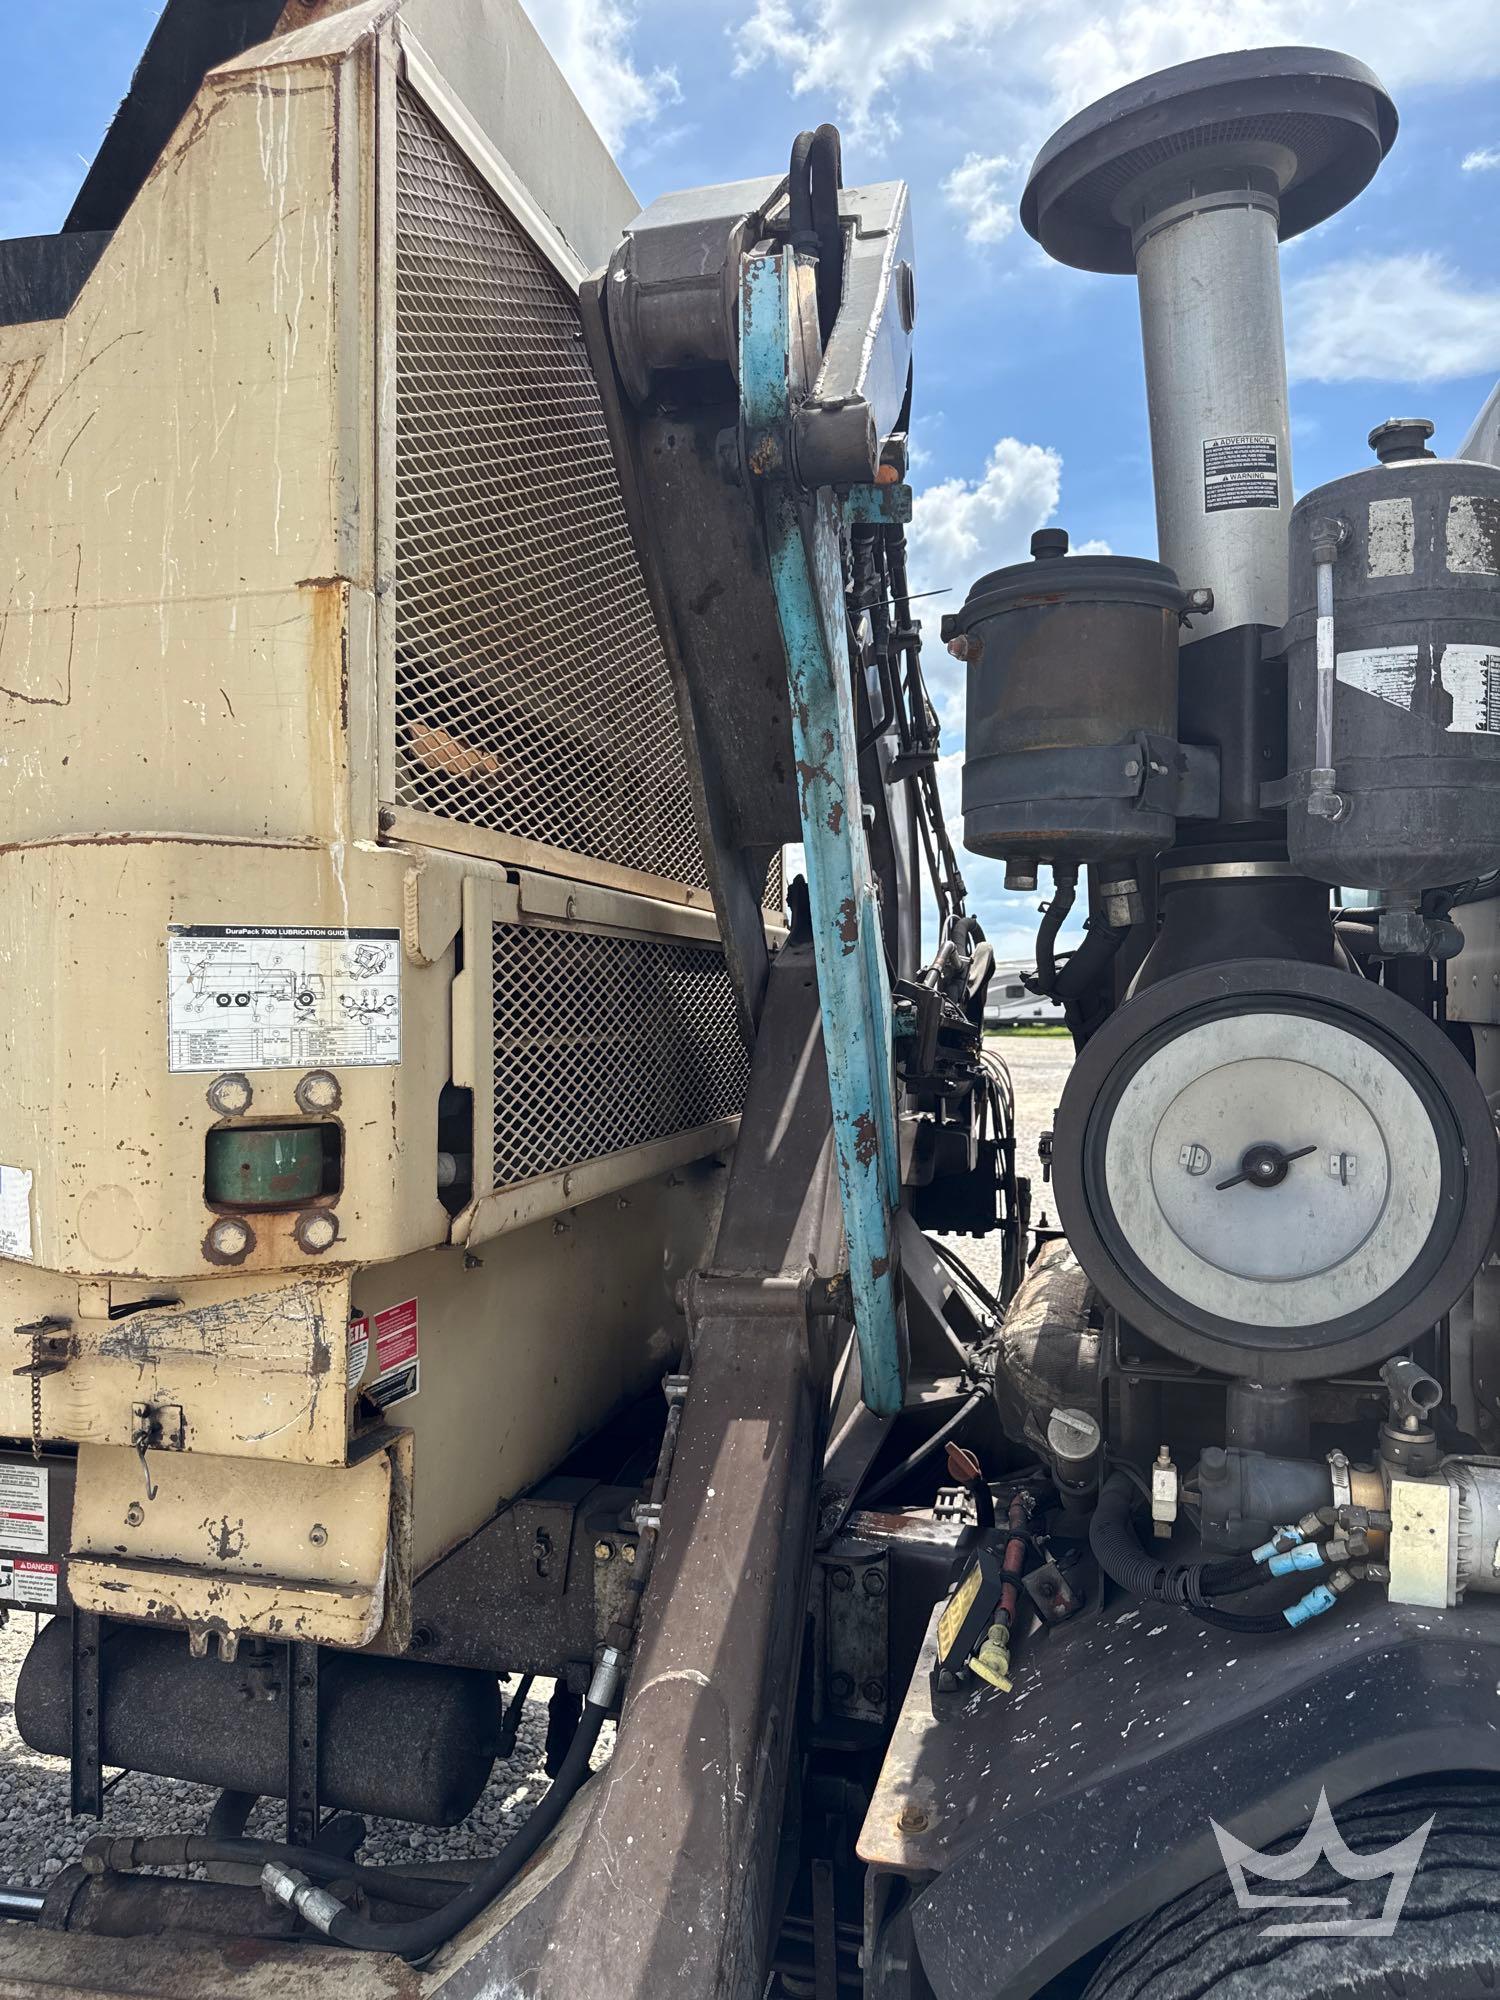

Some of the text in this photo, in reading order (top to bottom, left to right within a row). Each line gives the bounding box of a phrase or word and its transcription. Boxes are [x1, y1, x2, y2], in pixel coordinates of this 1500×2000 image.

[1220, 437, 1270, 445] ADVERTENCIA
[1230, 472, 1264, 480] WARNING
[225, 928, 260, 936] DuraPack
[27, 1562, 54, 1572] DANGER
